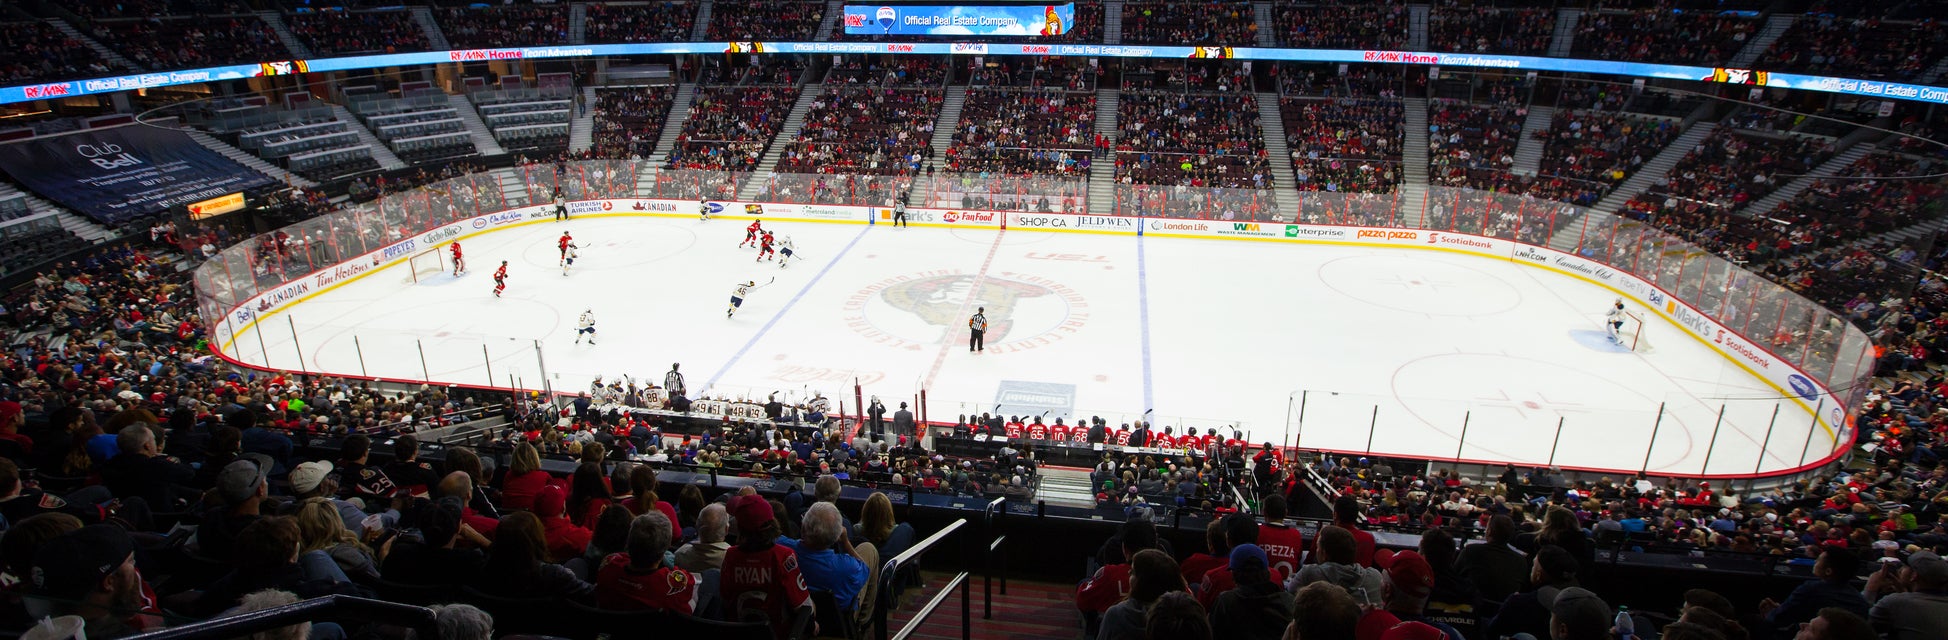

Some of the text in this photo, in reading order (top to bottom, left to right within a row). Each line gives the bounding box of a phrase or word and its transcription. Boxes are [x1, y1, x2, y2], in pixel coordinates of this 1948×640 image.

[904, 15, 1018, 27] Official Real Estate Company
[450, 48, 593, 61] RE/MAX Home Team Advantage
[887, 44, 914, 52] RE/MAX
[1022, 45, 1050, 53] RE/MAX
[1061, 46, 1084, 54] Official
[1122, 48, 1154, 57] Company
[1364, 50, 1520, 68] RE/MAX Home Team Advantage
[86, 71, 210, 92] Official Real Estate Company
[1821, 78, 1858, 91] Official
[1859, 82, 1883, 94] Real
[1884, 84, 1918, 98] Estate
[24, 83, 69, 98] RE/MAX
[76, 142, 122, 158] Club
[90, 153, 143, 170] Bell
[643, 202, 677, 212] CANADIAN
[892, 209, 933, 222] ark's
[1163, 222, 1209, 232] London Life
[1233, 222, 1260, 232] WM
[1357, 229, 1418, 241] pizza pizza
[1441, 236, 1493, 249] Scotiabank
[1515, 250, 1547, 263] LNH.COM
[1554, 254, 1614, 281] Canadian Club
[315, 263, 369, 288] Tim Hortons
[268, 282, 308, 306] CANADIAN
[1649, 288, 1664, 307] Bell
[236, 305, 252, 324] Bell
[1673, 303, 1712, 337] Mark's
[1725, 337, 1770, 370] Scotiabank
[646, 393, 658, 403] 88
[815, 403, 826, 414] 25
[1030, 429, 1044, 440] 65
[1075, 432, 1088, 443] 68
[371, 478, 392, 495] 25
[735, 566, 772, 584] RYAN
[1432, 616, 1475, 626] HEVROLET
